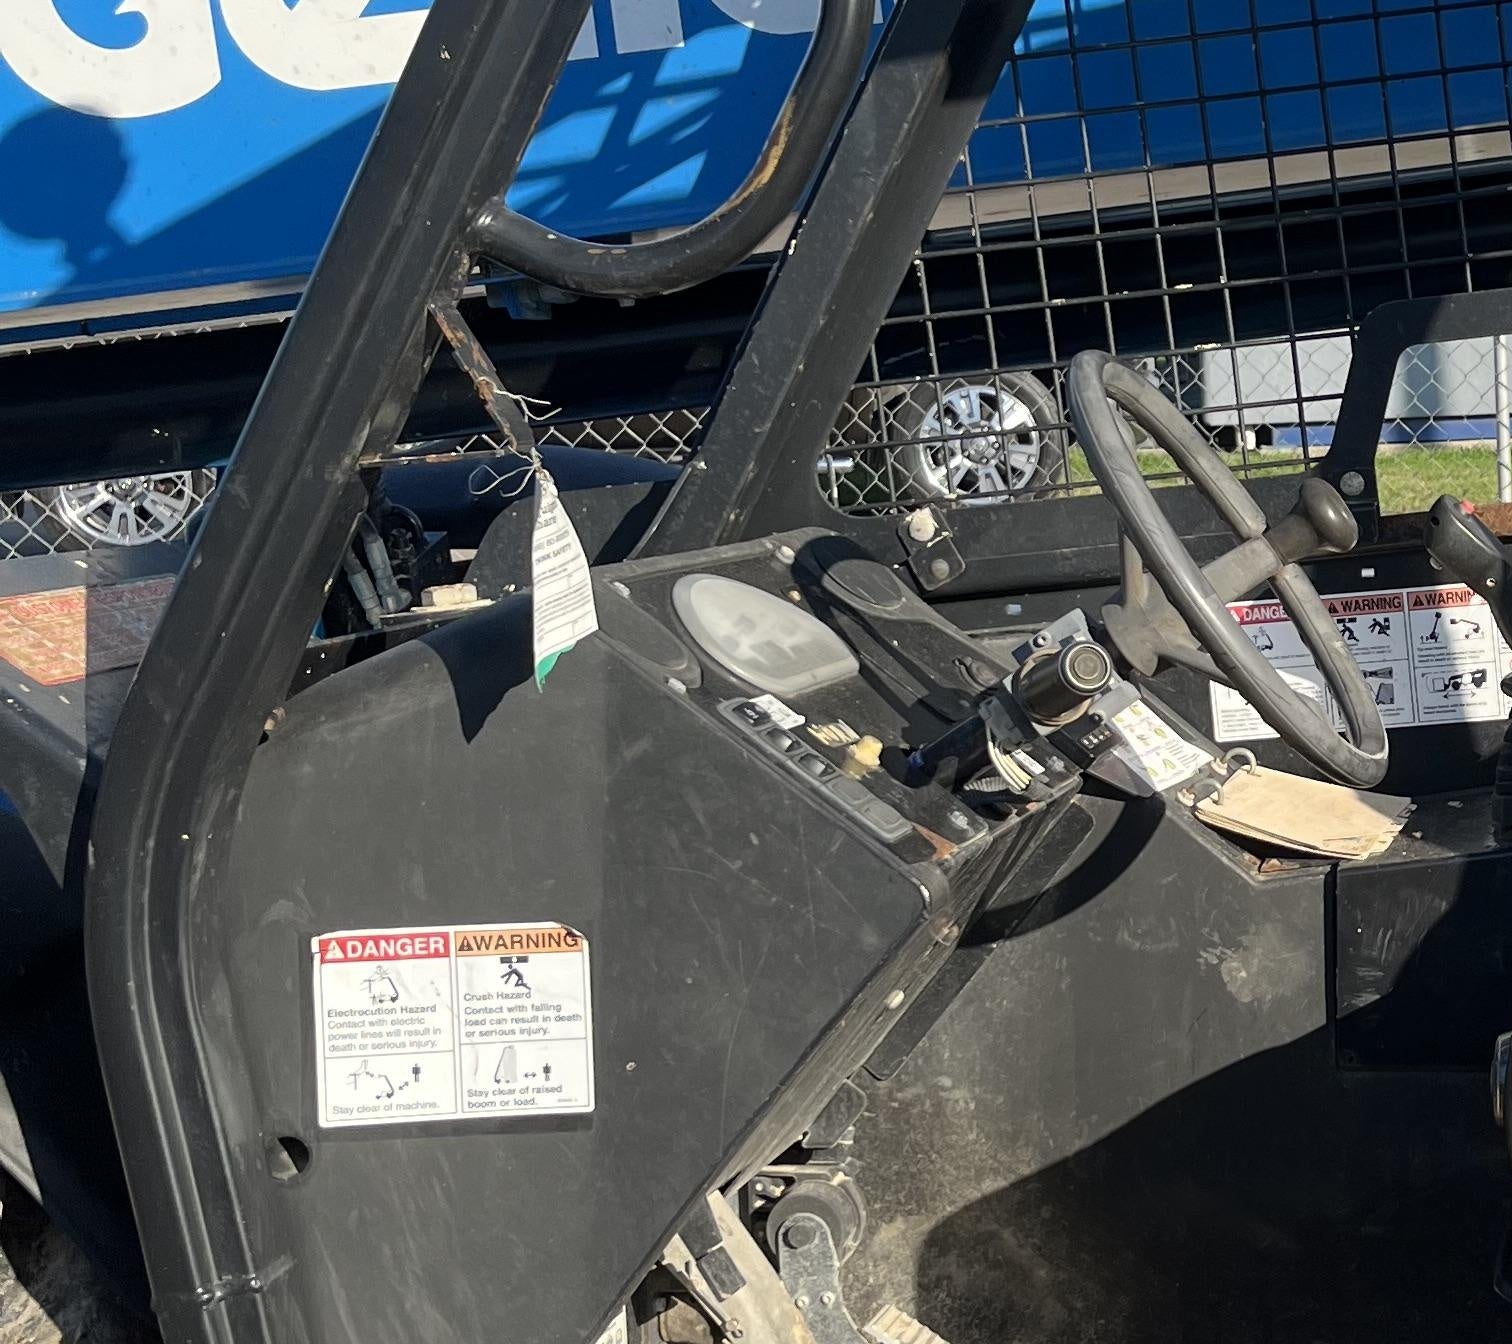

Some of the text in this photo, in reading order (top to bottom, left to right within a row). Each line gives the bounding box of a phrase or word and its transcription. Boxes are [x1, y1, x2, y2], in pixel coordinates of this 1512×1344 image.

[1341, 596, 1401, 613] WARNING
[1425, 590, 1476, 606] WARNIN
[1243, 604, 1287, 621] DANGE
[347, 935, 445, 959] DANGER
[474, 931, 579, 952] WARNING
[464, 991, 531, 1001] Crush Hazard
[328, 1004, 437, 1018] Electrocution Hazard
[465, 1003, 562, 1015] Contact with falling
[328, 1017, 425, 1029] Contact with electric
[465, 1018, 486, 1026] load
[511, 1015, 539, 1024] result
[542, 1015, 551, 1023] in
[554, 1013, 582, 1022] death
[328, 1026, 441, 1042] power lines will result in
[479, 1028, 516, 1037] serious
[519, 1027, 550, 1036] injury.
[329, 1044, 356, 1052] death
[371, 1041, 406, 1050] serious
[467, 1085, 563, 1098] Stay clear of raised
[333, 1105, 354, 1115] Stay
[357, 1104, 380, 1113] clear
[384, 1103, 392, 1111] of
[468, 1100, 496, 1109] boom
[514, 1098, 538, 1106] load.
